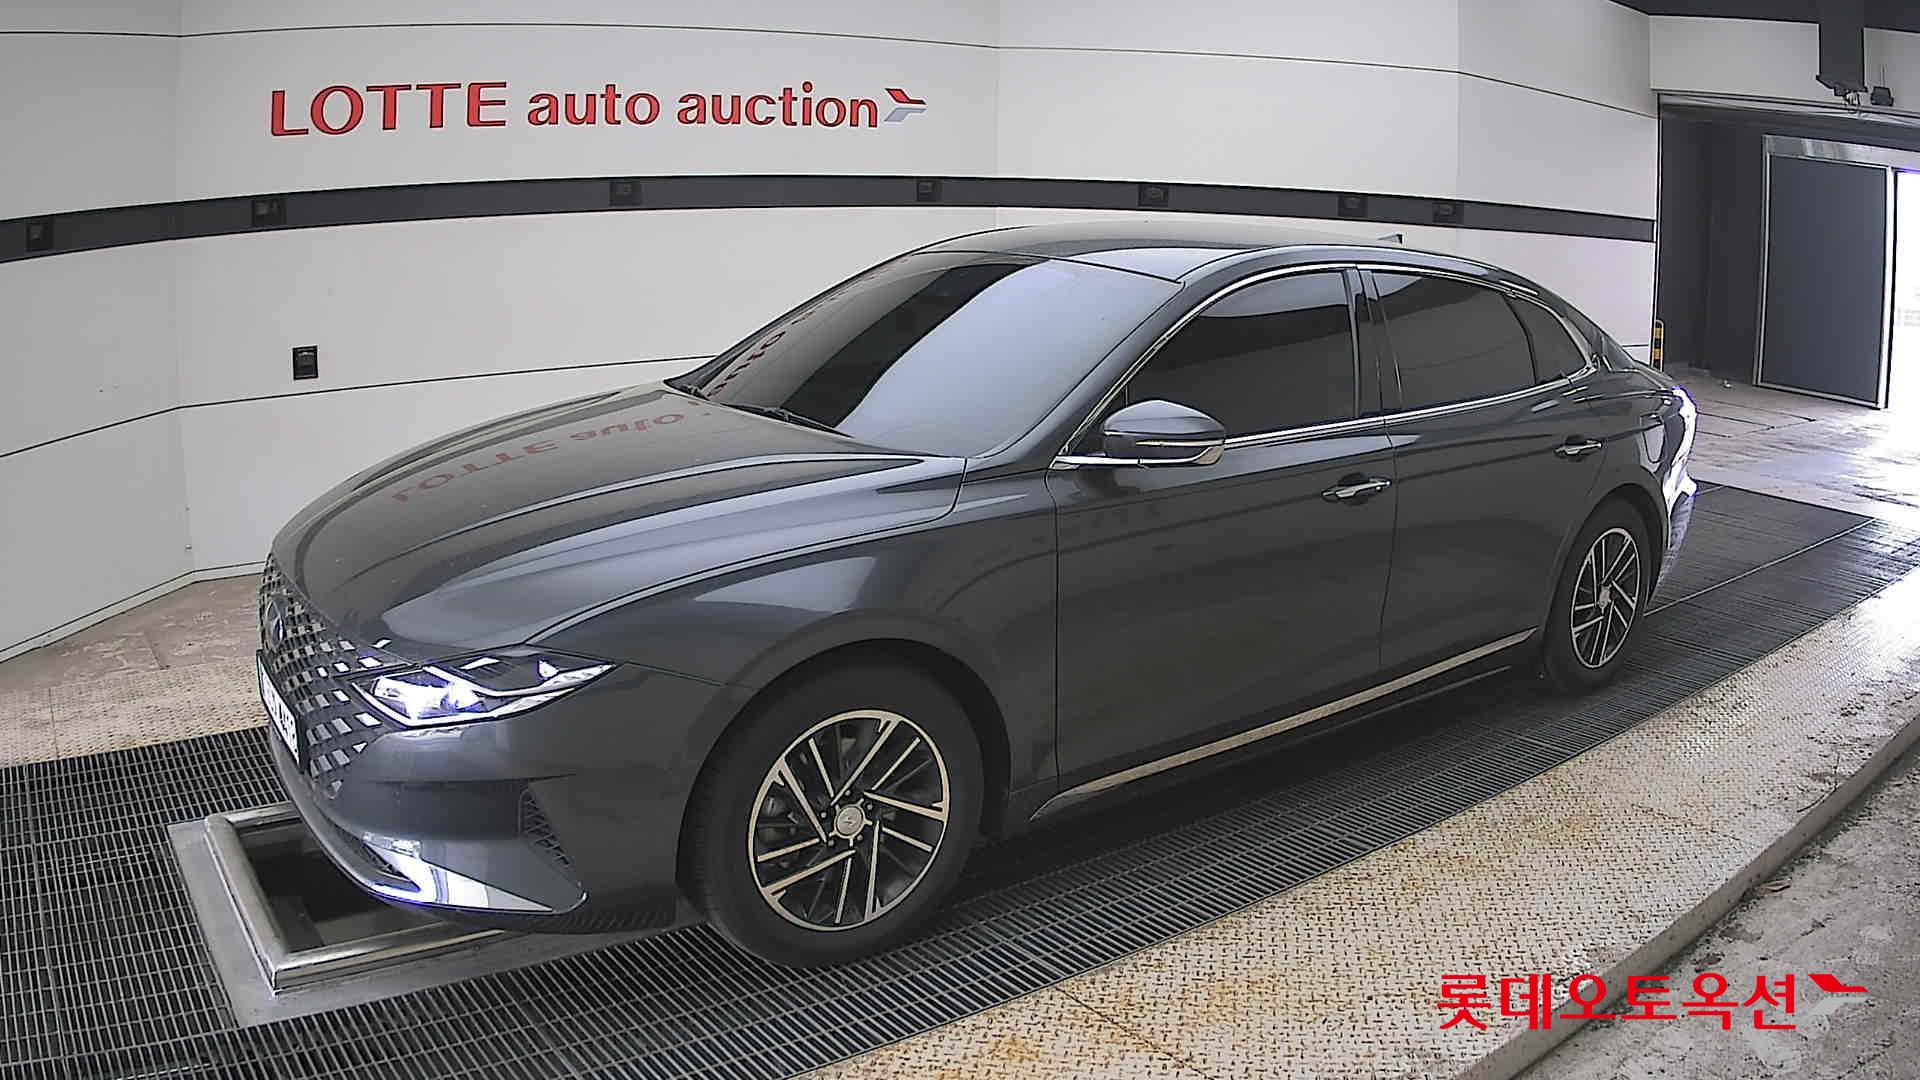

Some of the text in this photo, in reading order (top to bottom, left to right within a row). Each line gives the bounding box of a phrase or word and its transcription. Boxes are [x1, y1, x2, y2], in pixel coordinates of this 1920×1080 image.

[270, 81, 879, 136] LOTTE auto auction
